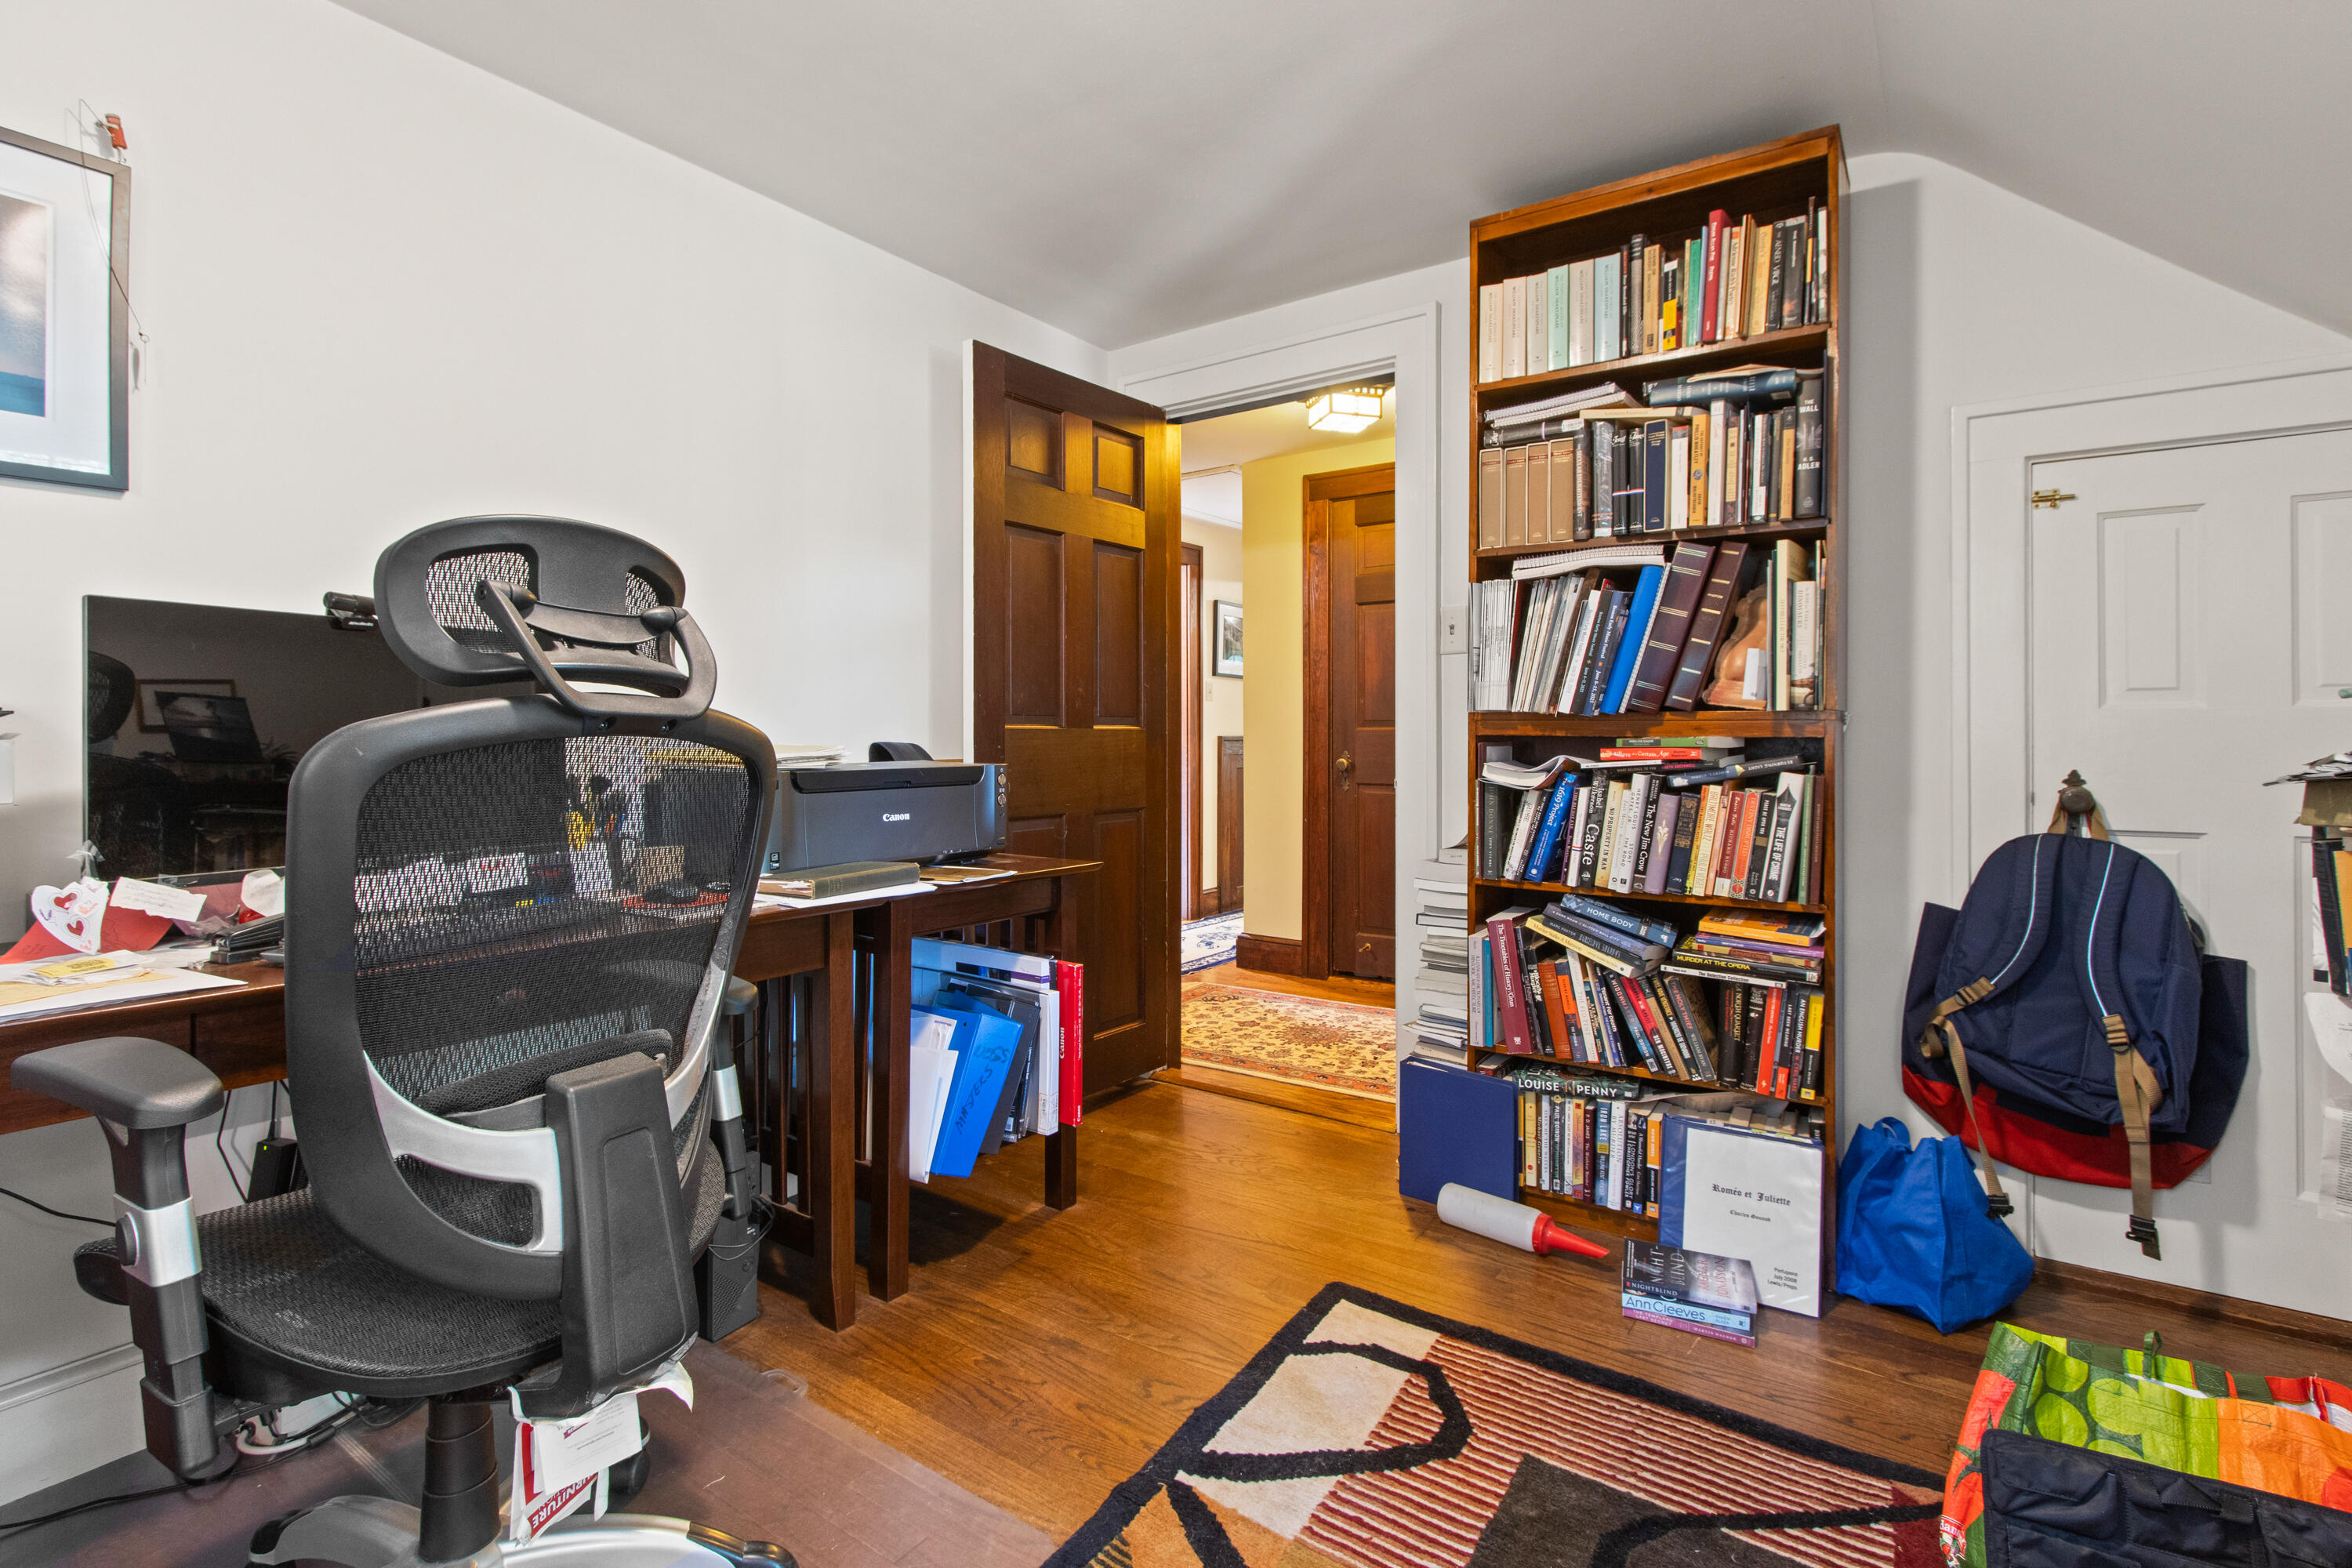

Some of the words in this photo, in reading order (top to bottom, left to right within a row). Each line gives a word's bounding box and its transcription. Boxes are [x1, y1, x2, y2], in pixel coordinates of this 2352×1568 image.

[1799, 405, 1819, 413] WALL
[1798, 462, 1820, 470] ADLER
[1555, 786, 1565, 803] 1619
[1588, 780, 1599, 814] Wilkerson
[1595, 788, 1604, 808] Isabel
[1546, 803, 1559, 826] Project
[1646, 804, 1656, 818] The
[1706, 791, 1719, 822] BALTIMORE
[1748, 797, 1757, 822] DESTINY
[883, 813, 909, 822] Canon
[1604, 816, 1613, 848] PROPERTY
[1643, 820, 1654, 837] New
[1703, 824, 1713, 841] WALTZ
[1776, 827, 1786, 838] THE
[1582, 824, 1599, 865] Caste
[1641, 837, 1650, 850] Jim
[1741, 823, 1754, 856] DISRUPTED
[1773, 839, 1784, 852] LIFE
[1638, 851, 1649, 872] Crow
[1699, 853, 1709, 873] PAULA
[1773, 852, 1781, 861] OF
[1769, 861, 1780, 881] CRIME
[1694, 874, 1705, 890] VOGEL
[1587, 907, 1609, 920] HOME
[1611, 915, 1634, 929] BODY
[1500, 936, 1508, 964] Timetables
[1504, 972, 1515, 1007] History/Grun
[1677, 955, 1703, 964] MURDER
[1727, 962, 1751, 971] OPERA
[1533, 971, 1543, 994] Bloody
[1800, 999, 1806, 1007] AN
[1607, 1015, 1617, 1032] Death
[1611, 979, 1635, 1023] WIDOWMAKER
[1639, 1040, 1650, 1057] DOIRON
[1797, 1007, 1806, 1030] ENGLISH
[1675, 994, 1686, 1011] HOLY
[1681, 1012, 1693, 1029] THIEF
[1697, 1054, 1707, 1067] RYAN
[1518, 1079, 1559, 1091] LOUISE
[1577, 1085, 1617, 1098] PENNY
[1757, 1192, 1791, 1207] Juliette
[1730, 1210, 1749, 1218] Charles
[1751, 1214, 1771, 1222] Gounod
[1670, 1252, 1686, 1286] BLIND
[1632, 1282, 1678, 1296] NIGHTBLIND
[1626, 1297, 1651, 1311] Ann
[1653, 1301, 1705, 1321] Cleeves
[1650, 1317, 1672, 1327] SECRET
[1693, 1327, 1714, 1335] MARTIN
[1715, 1330, 1737, 1341] WALKER
